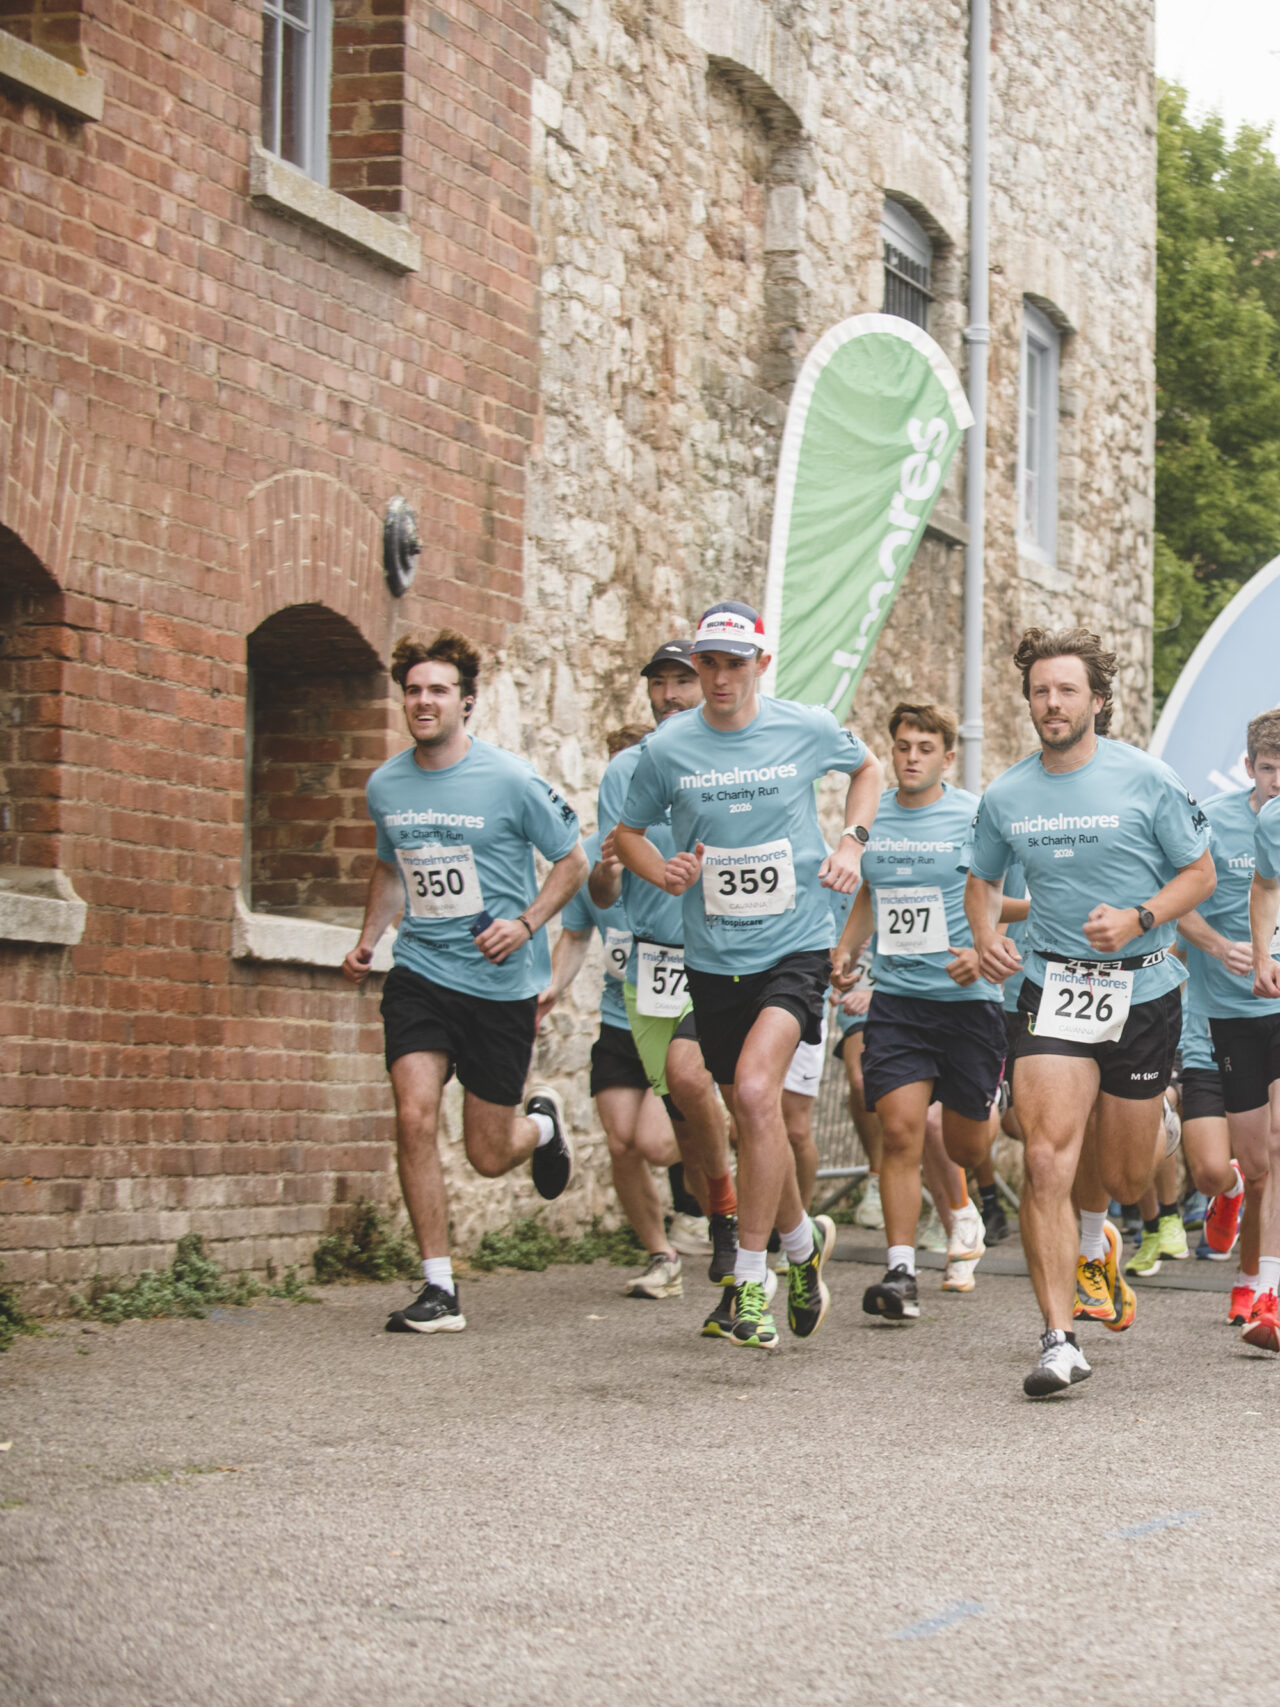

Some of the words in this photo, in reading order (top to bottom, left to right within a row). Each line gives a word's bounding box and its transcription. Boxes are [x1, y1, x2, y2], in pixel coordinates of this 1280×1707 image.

[680, 763, 798, 789] michelmores
[701, 791, 714, 802] 5k
[716, 789, 755, 802] Charity
[758, 787, 779, 796] Run
[729, 802, 752, 813] 2026
[384, 808, 485, 829] michelmores
[1011, 813, 1120, 835] michelmores
[412, 830, 443, 842] Charity
[446, 831, 464, 841] Run
[1028, 836, 1039, 847] 5k
[1041, 834, 1076, 847] Charity
[1079, 834, 1099, 844] Run
[865, 837, 954, 853] michelmores
[402, 854, 470, 866] michelmores
[705, 849, 787, 866] michelmores
[888, 855, 916, 865] Charity
[917, 856, 935, 864] Run
[1053, 849, 1075, 858] 2026
[413, 868, 465, 898] 350
[718, 866, 779, 896] 359
[880, 893, 938, 905] michelmores
[888, 907, 930, 934] 297
[1050, 971, 1127, 990] michelmores
[1055, 988, 1113, 1022] 226
